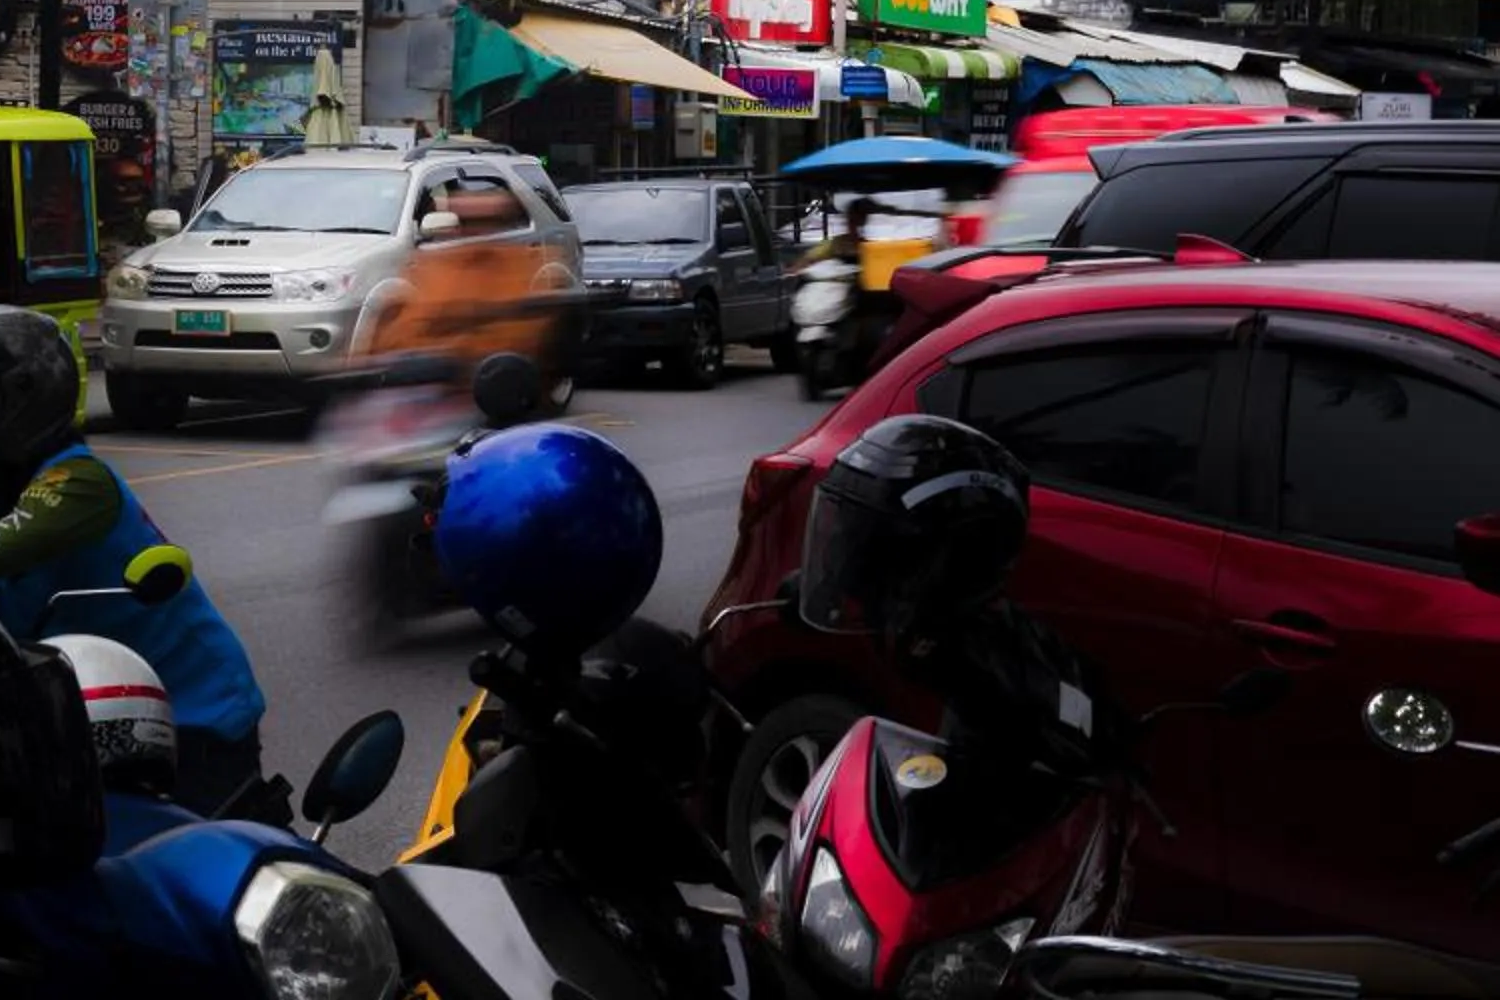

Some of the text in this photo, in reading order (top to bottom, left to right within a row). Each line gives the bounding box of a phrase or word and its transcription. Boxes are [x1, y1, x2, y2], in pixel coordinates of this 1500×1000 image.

[84, 5, 116, 22] 199
[255, 46, 269, 56] on
[271, 45, 289, 56] the
[111, 117, 143, 130] FRIES
